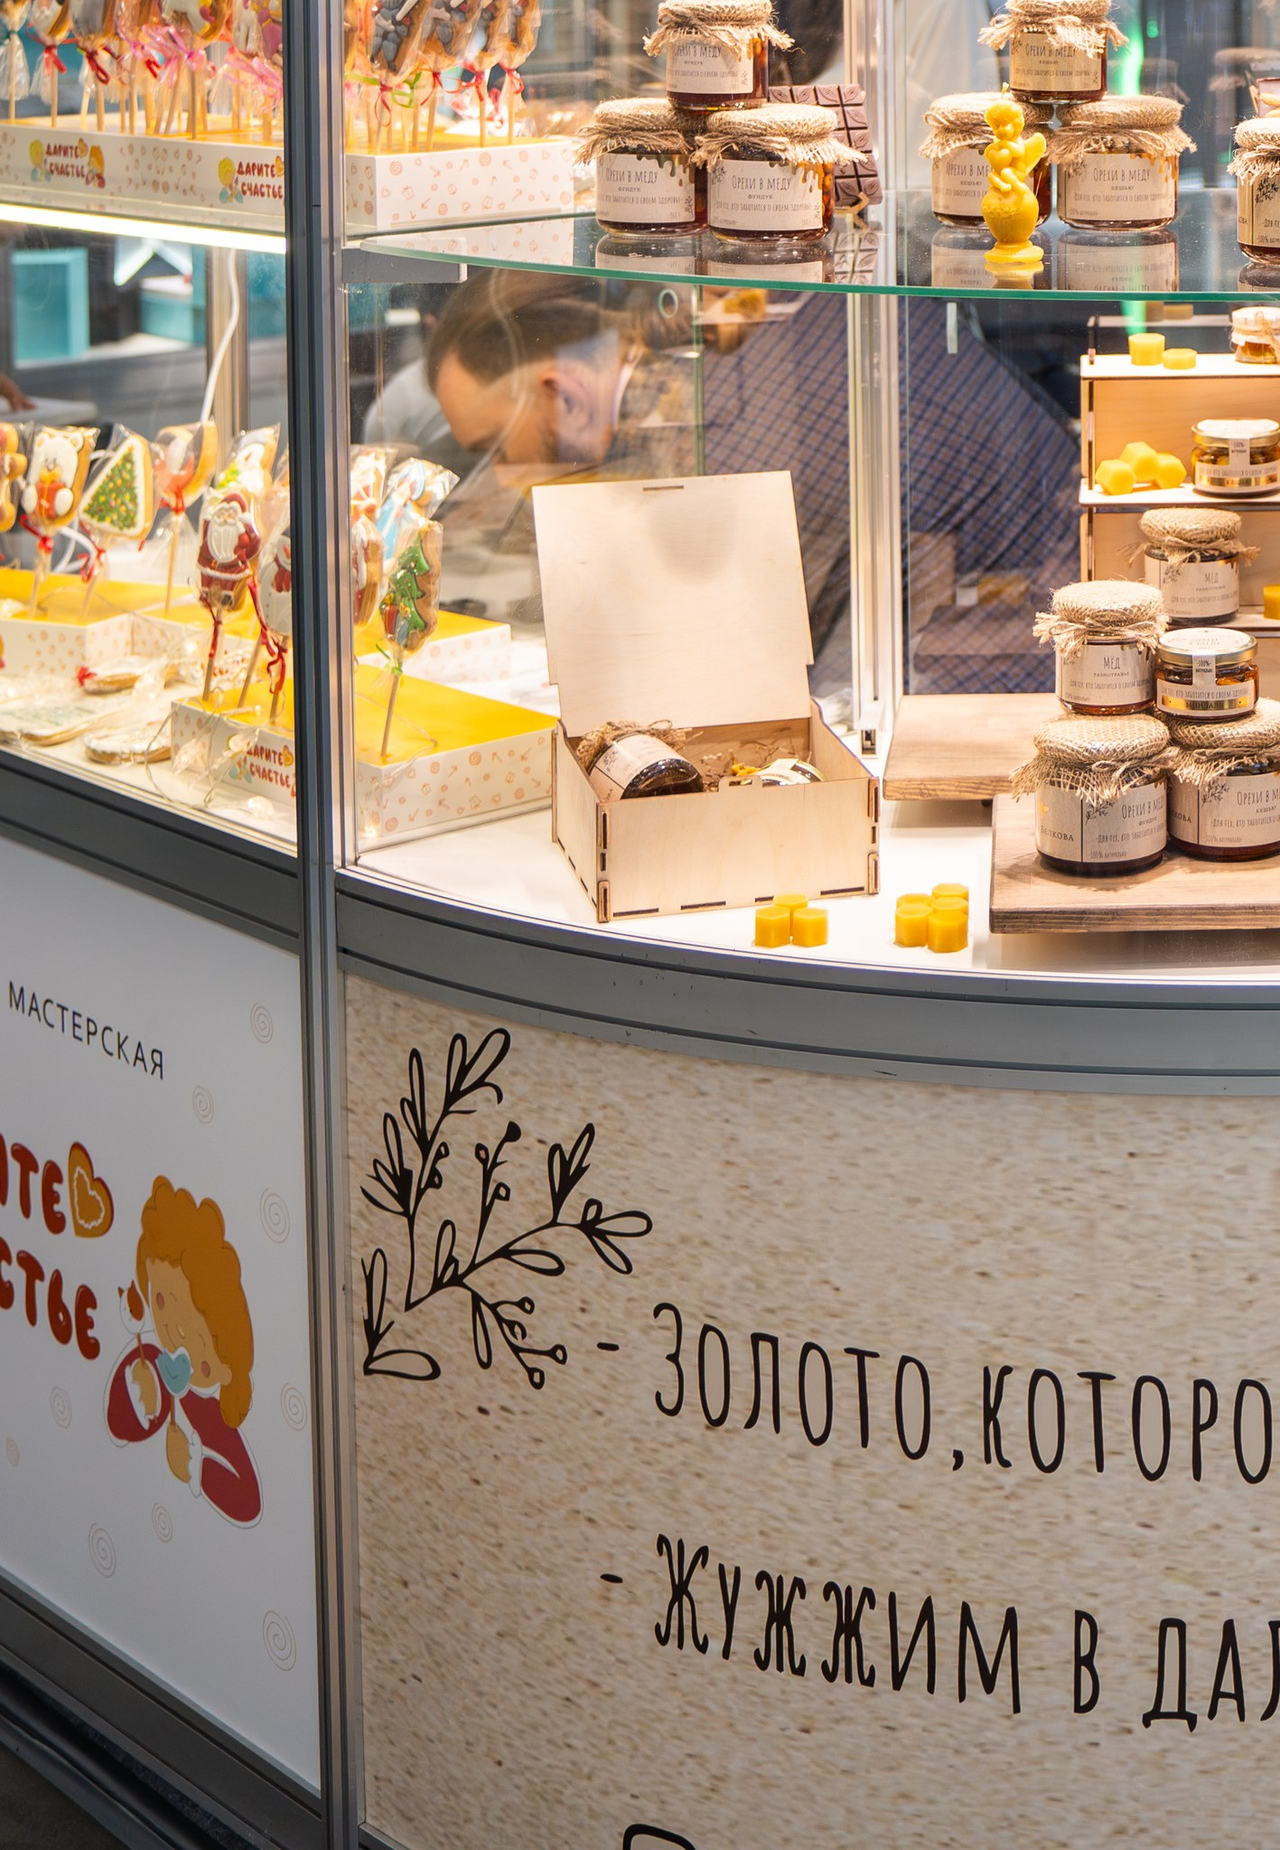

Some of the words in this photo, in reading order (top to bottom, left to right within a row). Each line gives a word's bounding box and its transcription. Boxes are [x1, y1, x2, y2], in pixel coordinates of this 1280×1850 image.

[1025, 43, 1046, 58] ОРЕХИ
[46, 143, 80, 160] ДАРИТЕ
[49, 162, 86, 179] СЧАСТЬЕ
[237, 161, 277, 180] ДАРИТЕ
[605, 167, 628, 183] ОРЕХИ
[635, 168, 659, 184] МЕДУ
[947, 161, 967, 177] ОРЕХИ
[1093, 168, 1118, 182] ОРЕХИ
[241, 181, 284, 200] СЧАСТЬЕ
[732, 175, 756, 191] ОРЕХИ
[767, 177, 792, 191] МЕДУ
[249, 762, 291, 789] СЧАСТЬЕ
[1237, 790, 1263, 806] ОРЕХИ
[1121, 801, 1146, 819] ОРЕХИ
[1040, 825, 1074, 842] БЕЛКОВА
[9, 980, 165, 1081] МАСТЕРСКАЯ
[653, 1533, 1022, 1715] ЖУЖЖИМ
[1074, 1609, 1101, 1715] В
